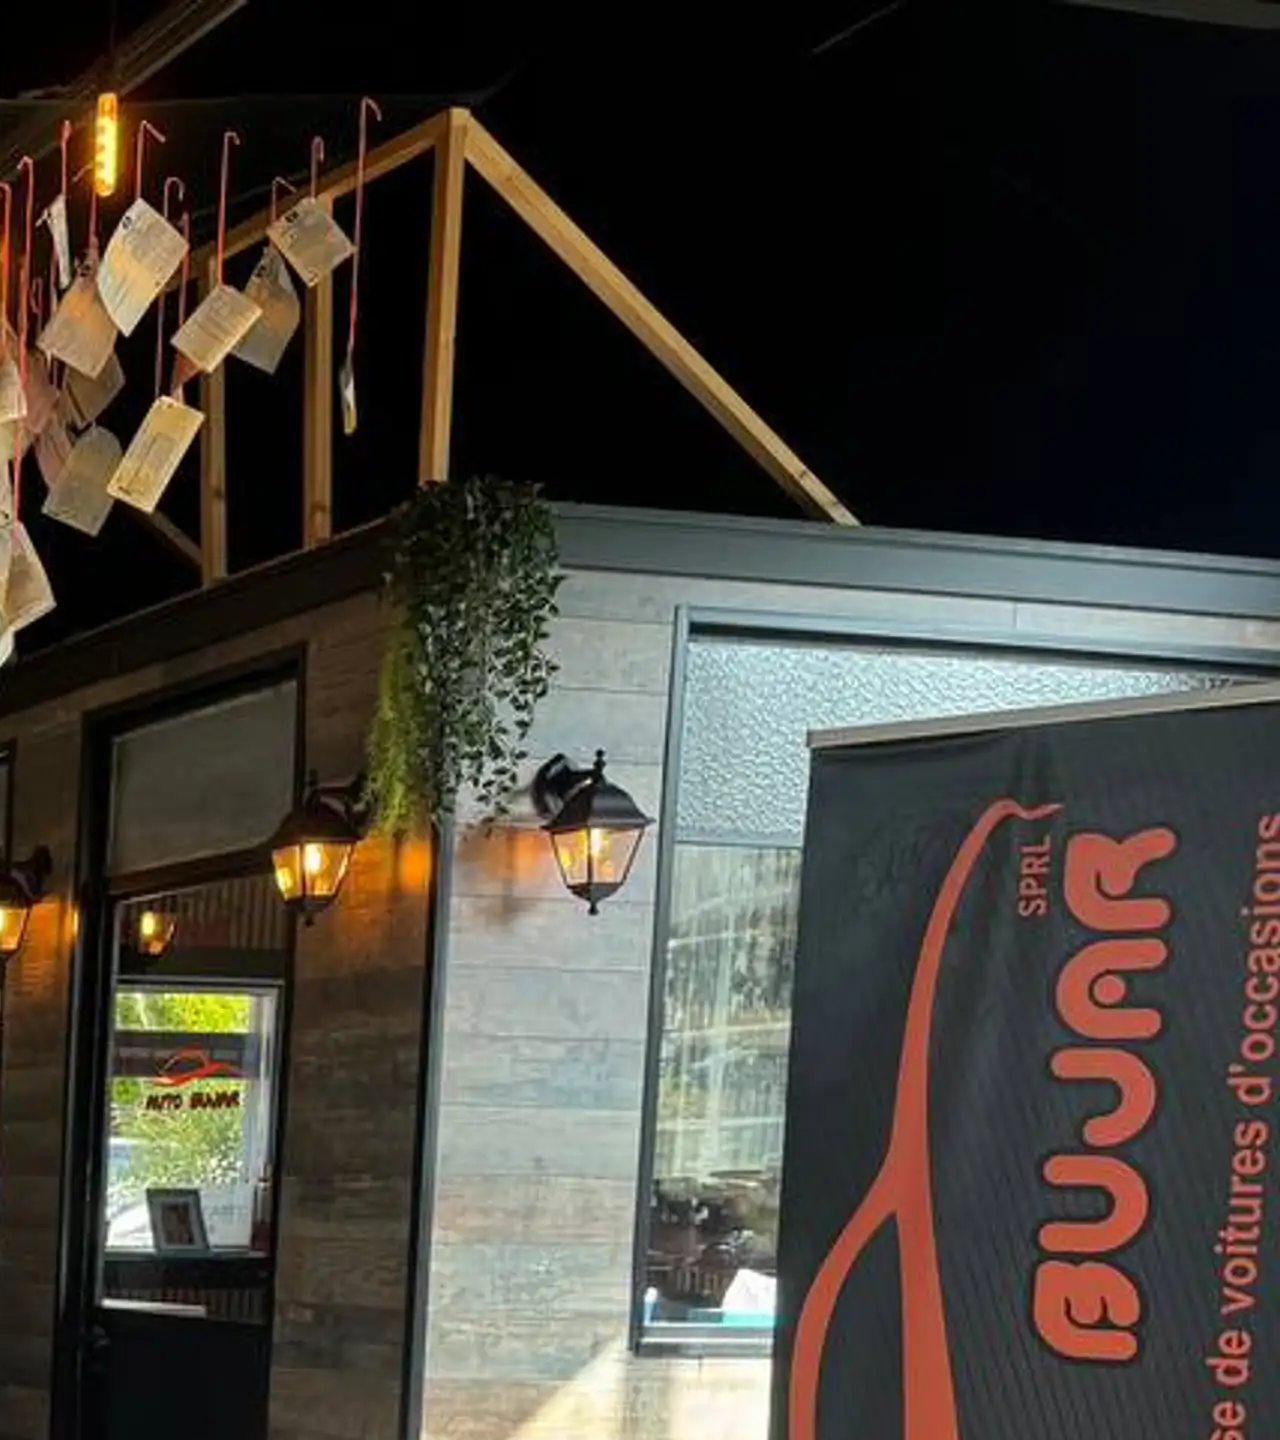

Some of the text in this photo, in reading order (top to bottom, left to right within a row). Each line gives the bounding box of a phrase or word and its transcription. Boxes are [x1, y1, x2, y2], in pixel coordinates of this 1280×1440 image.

[1018, 835, 1052, 918] SPRL
[1226, 813, 1280, 1105] d'occasions
[145, 1093, 183, 1111] AUTO
[1033, 829, 1176, 1360] BUJAR
[1214, 1120, 1268, 1312] voitures
[1206, 1332, 1250, 1387] de
